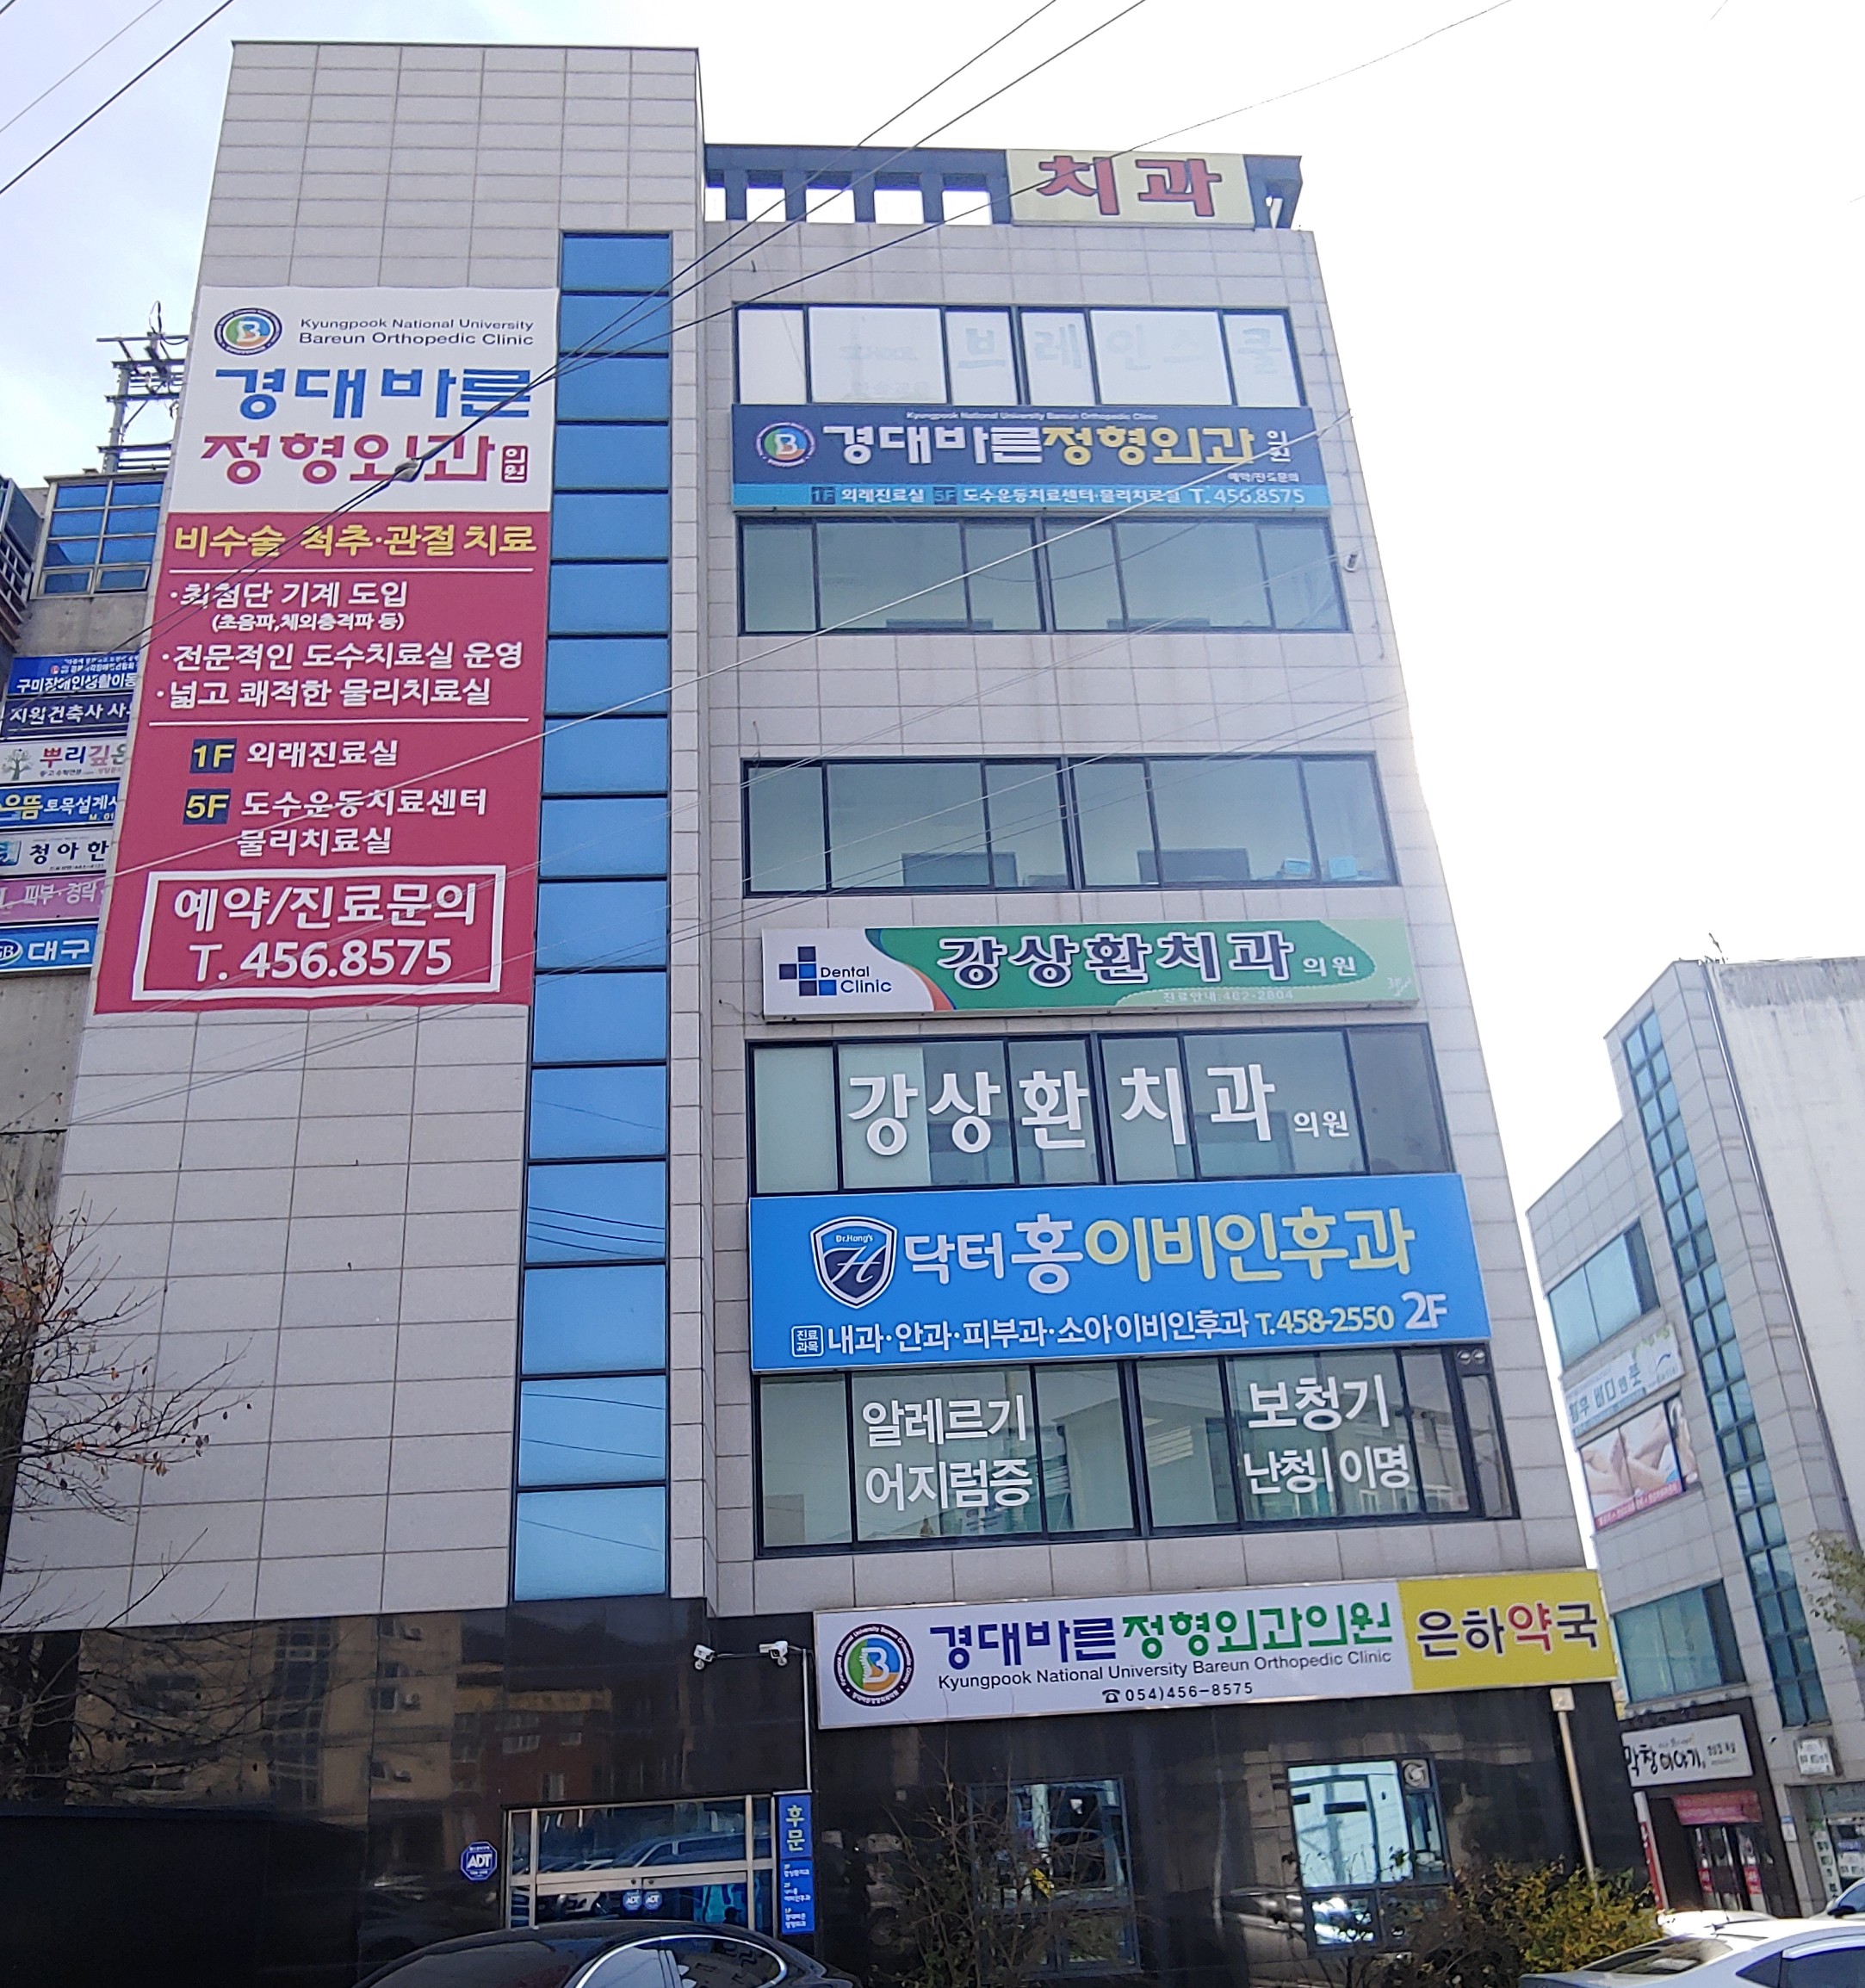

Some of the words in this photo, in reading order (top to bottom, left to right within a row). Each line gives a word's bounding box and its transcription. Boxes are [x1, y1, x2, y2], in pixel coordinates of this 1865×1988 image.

[1036, 155, 1222, 217] 치과
[299, 332, 365, 344] Bareun
[372, 331, 475, 346] Orthopedic
[482, 333, 534, 345] Clinic
[301, 318, 387, 331] Kyungpook
[393, 319, 454, 329] National
[459, 319, 534, 331] University
[214, 368, 531, 419] 경대바른
[201, 432, 495, 484] 정형외과
[823, 425, 1255, 466] 경대바른정형외과
[1267, 430, 1292, 463] 의원
[504, 447, 527, 482] 의원
[812, 488, 834, 503] 1F
[841, 487, 925, 504] 외래진료실
[934, 488, 957, 503] 5F
[1214, 488, 1305, 504] 456.8575
[174, 525, 286, 558] 비수술
[301, 524, 455, 557] 척추·관절
[463, 524, 536, 556] 치료
[180, 583, 274, 609] 최첨단
[282, 582, 340, 608] 기계
[348, 581, 408, 607] 도입
[378, 612, 405, 630] 등)
[173, 643, 294, 672] 전문적인
[302, 642, 454, 669] 도수치료실
[462, 641, 523, 669] 운영
[170, 680, 230, 709] 넓고
[238, 678, 332, 707] 쾌적한
[339, 678, 491, 707] 물리치료실
[9, 704, 104, 725] 지원건축사
[193, 744, 236, 767] 1F
[247, 740, 399, 768] 외래진료실
[185, 797, 230, 820] 5F
[240, 789, 486, 818] 도수운동치료센터
[237, 827, 393, 858] 물리치료실
[174, 882, 477, 932] 예약/진료문의
[28, 939, 90, 961] 대구
[189, 944, 228, 982] T.
[240, 938, 452, 981] 456.8575
[937, 931, 1294, 989] 강상환치과
[1303, 956, 1358, 977] 의원
[820, 965, 870, 978] Dental
[840, 980, 892, 994] Clinic
[1293, 1111, 1350, 1138] 의원
[836, 1234, 873, 1243] Dr.Hong's
[1255, 1305, 1395, 1335] T.458-2550
[1400, 1291, 1448, 1331] 2F
[796, 1329, 819, 1341] 진료
[796, 1341, 819, 1353] 과목
[1248, 1374, 1391, 1431] 보청기
[863, 1394, 1027, 1447] 알레르기
[865, 1458, 1032, 1511] 어지럼증
[930, 1601, 1392, 1670] 경대바른정형외과의원
[1417, 1601, 1598, 1658] 은하약국
[939, 1670, 1032, 1690] Kyungpook
[1037, 1666, 1103, 1684] National
[1108, 1662, 1187, 1680] University
[1193, 1658, 1249, 1675] Bareun
[1255, 1652, 1342, 1671] Orthopedic
[1348, 1650, 1392, 1665] Clinic
[1125, 1681, 1253, 1702] 054)456-8575
[785, 1805, 805, 1852] 후문
[468, 1854, 493, 1868] ADT
[625, 1895, 640, 1904] ADT
[646, 1895, 660, 1904] ADT
